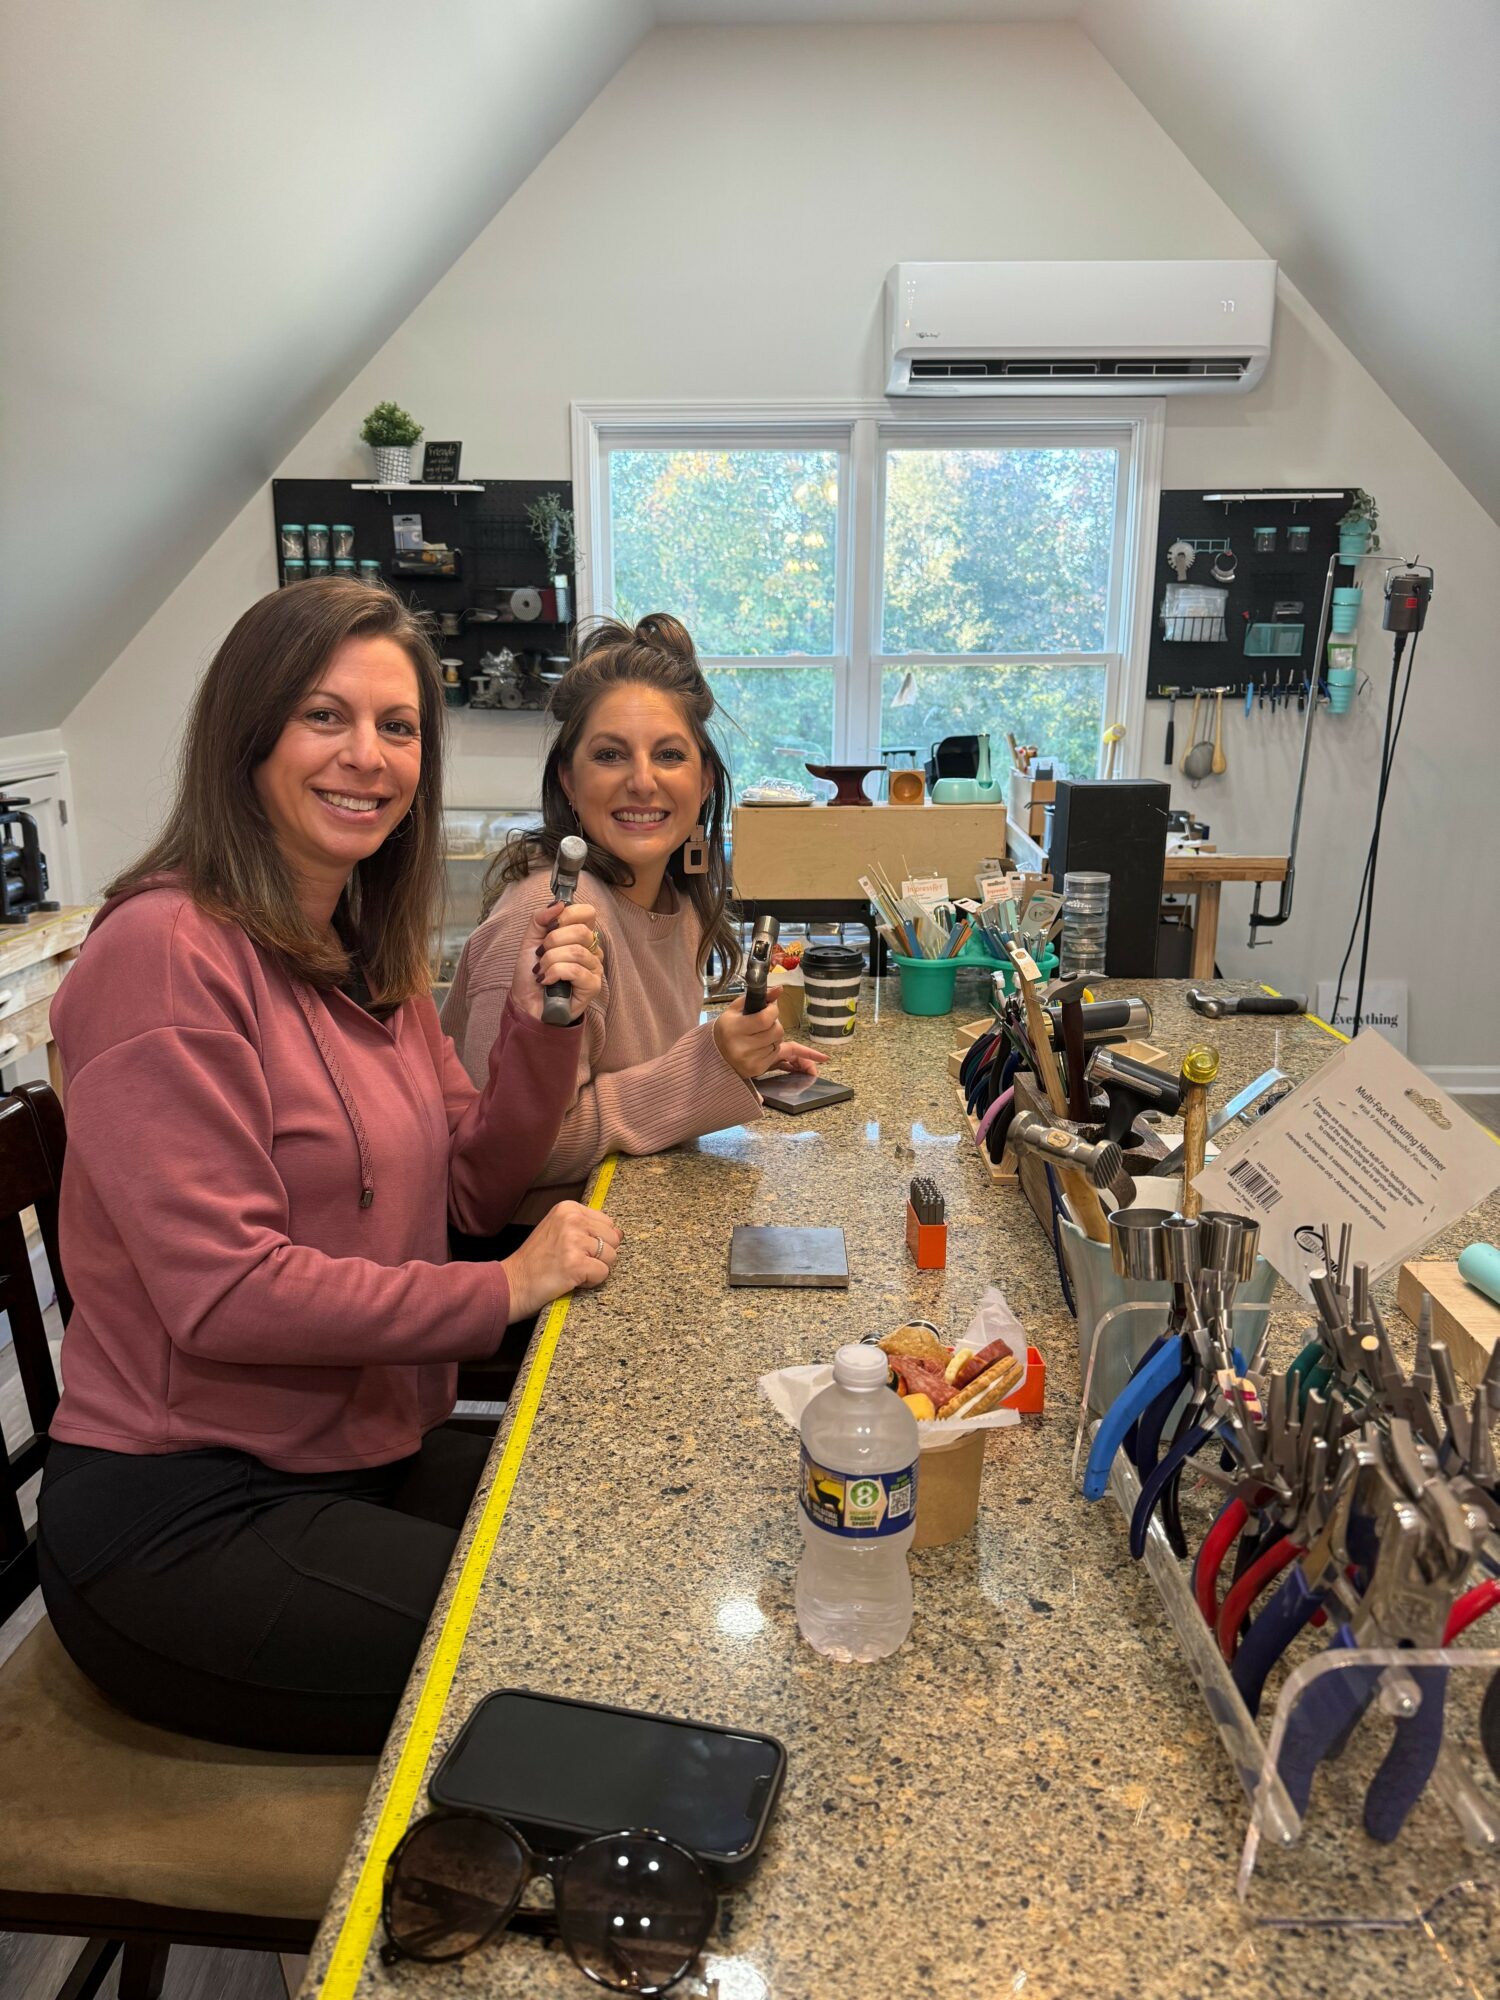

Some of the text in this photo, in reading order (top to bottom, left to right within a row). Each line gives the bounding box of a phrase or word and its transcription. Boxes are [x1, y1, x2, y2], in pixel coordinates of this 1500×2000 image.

[1355, 1085, 1446, 1171] Multi-Face Texturing Hammer
